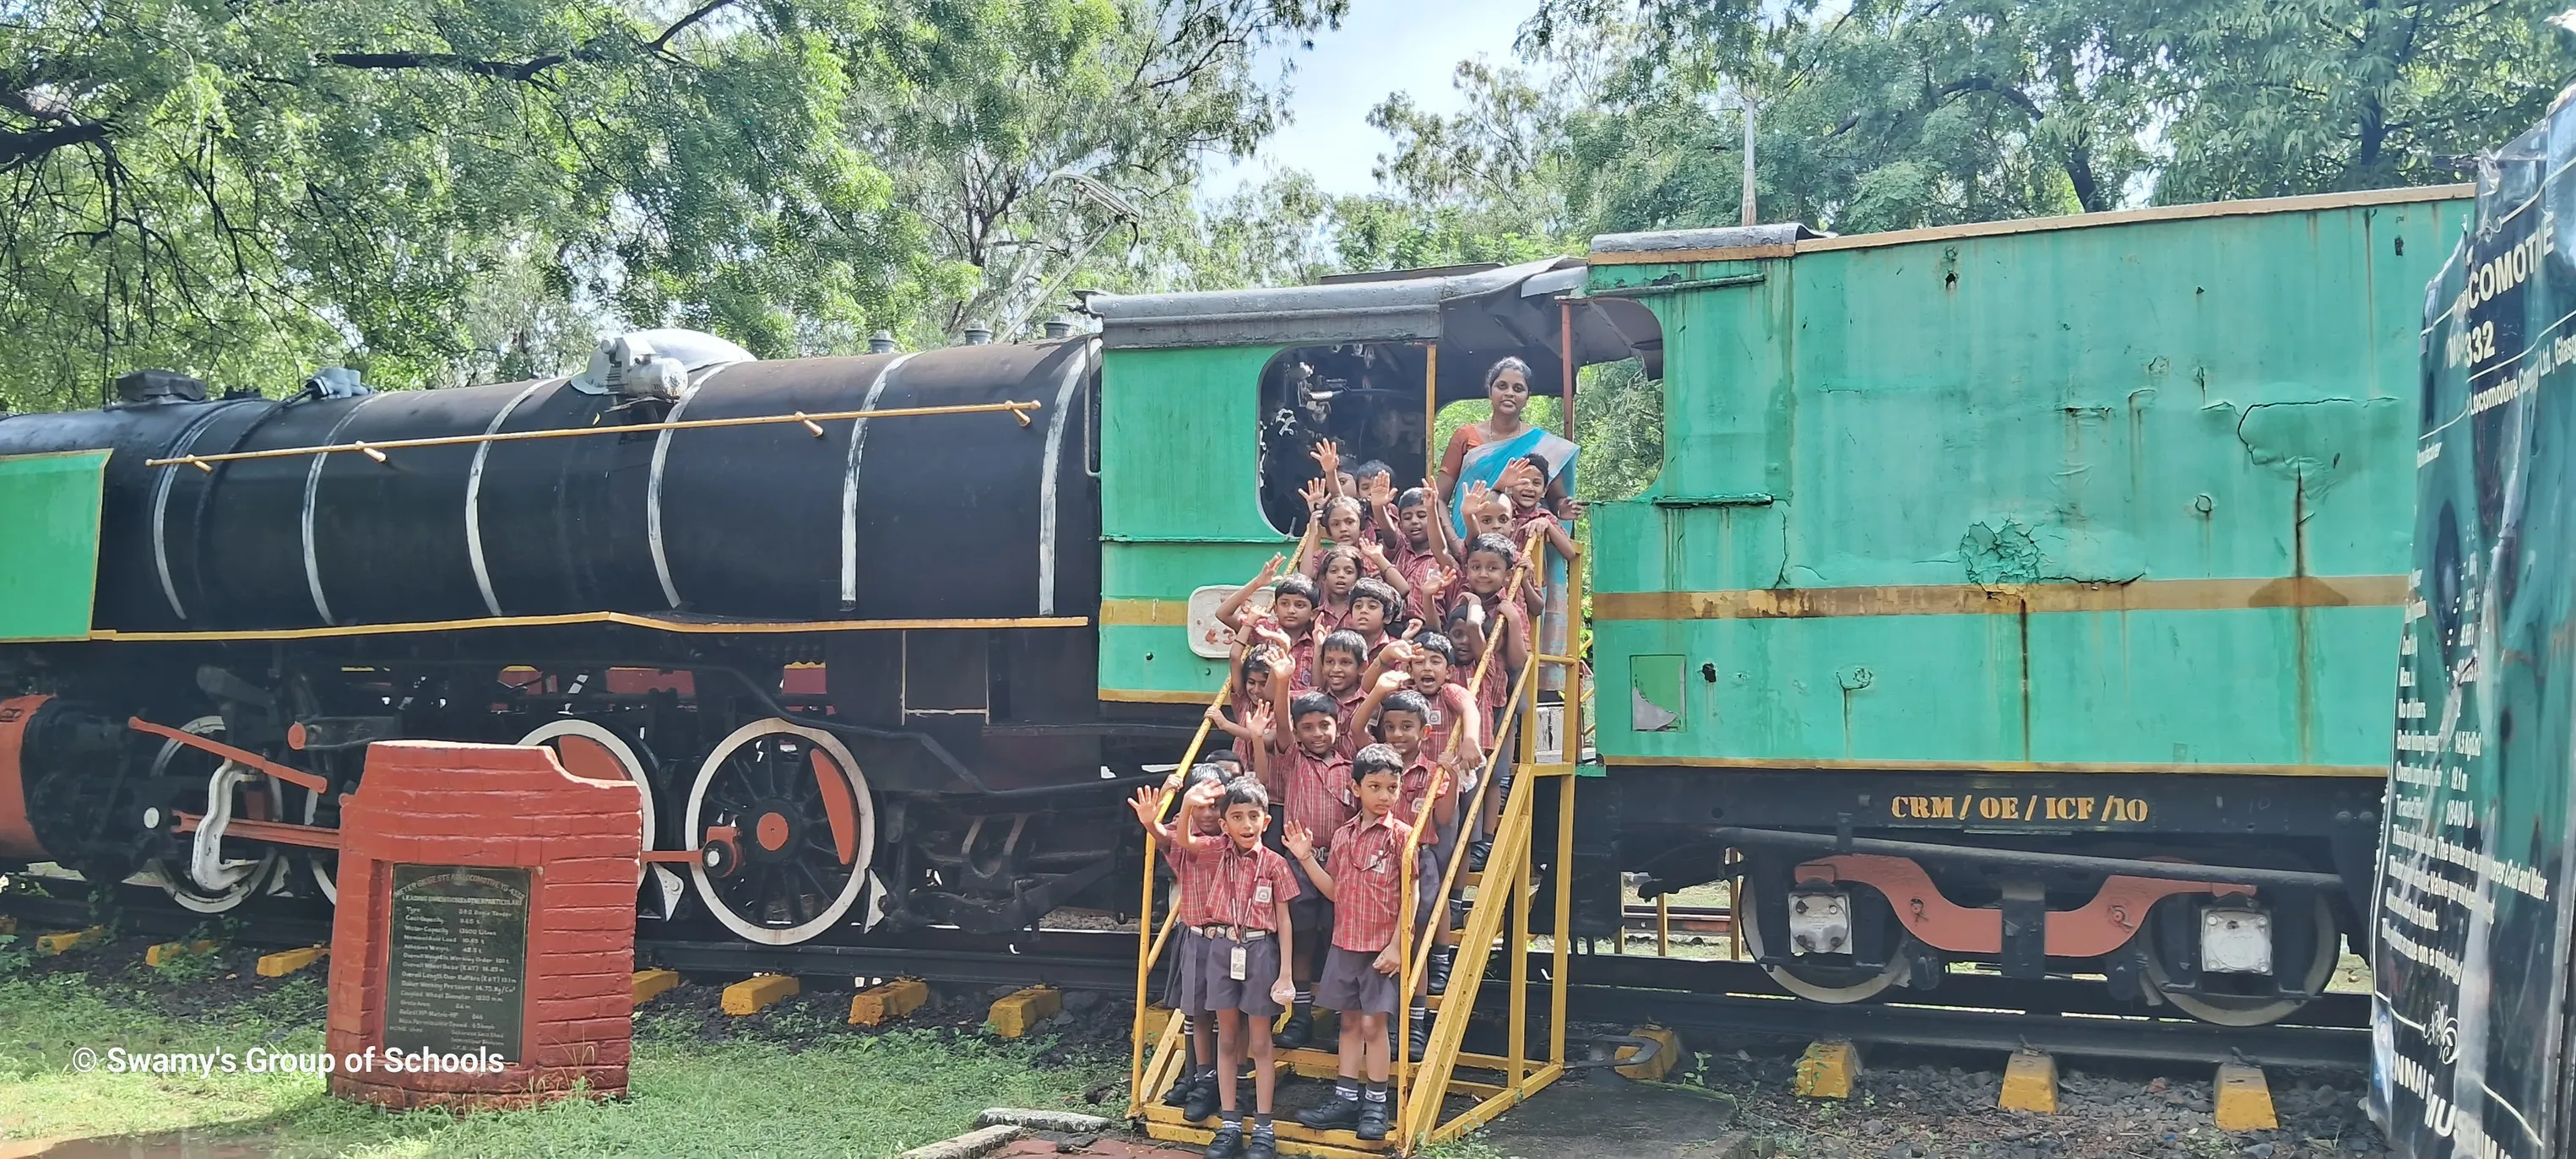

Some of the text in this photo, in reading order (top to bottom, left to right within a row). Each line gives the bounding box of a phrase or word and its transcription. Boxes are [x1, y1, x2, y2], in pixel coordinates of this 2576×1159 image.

[1891, 796, 1953, 819] CRM
[1979, 797, 2020, 820] OE
[2045, 797, 2095, 821] ICF
